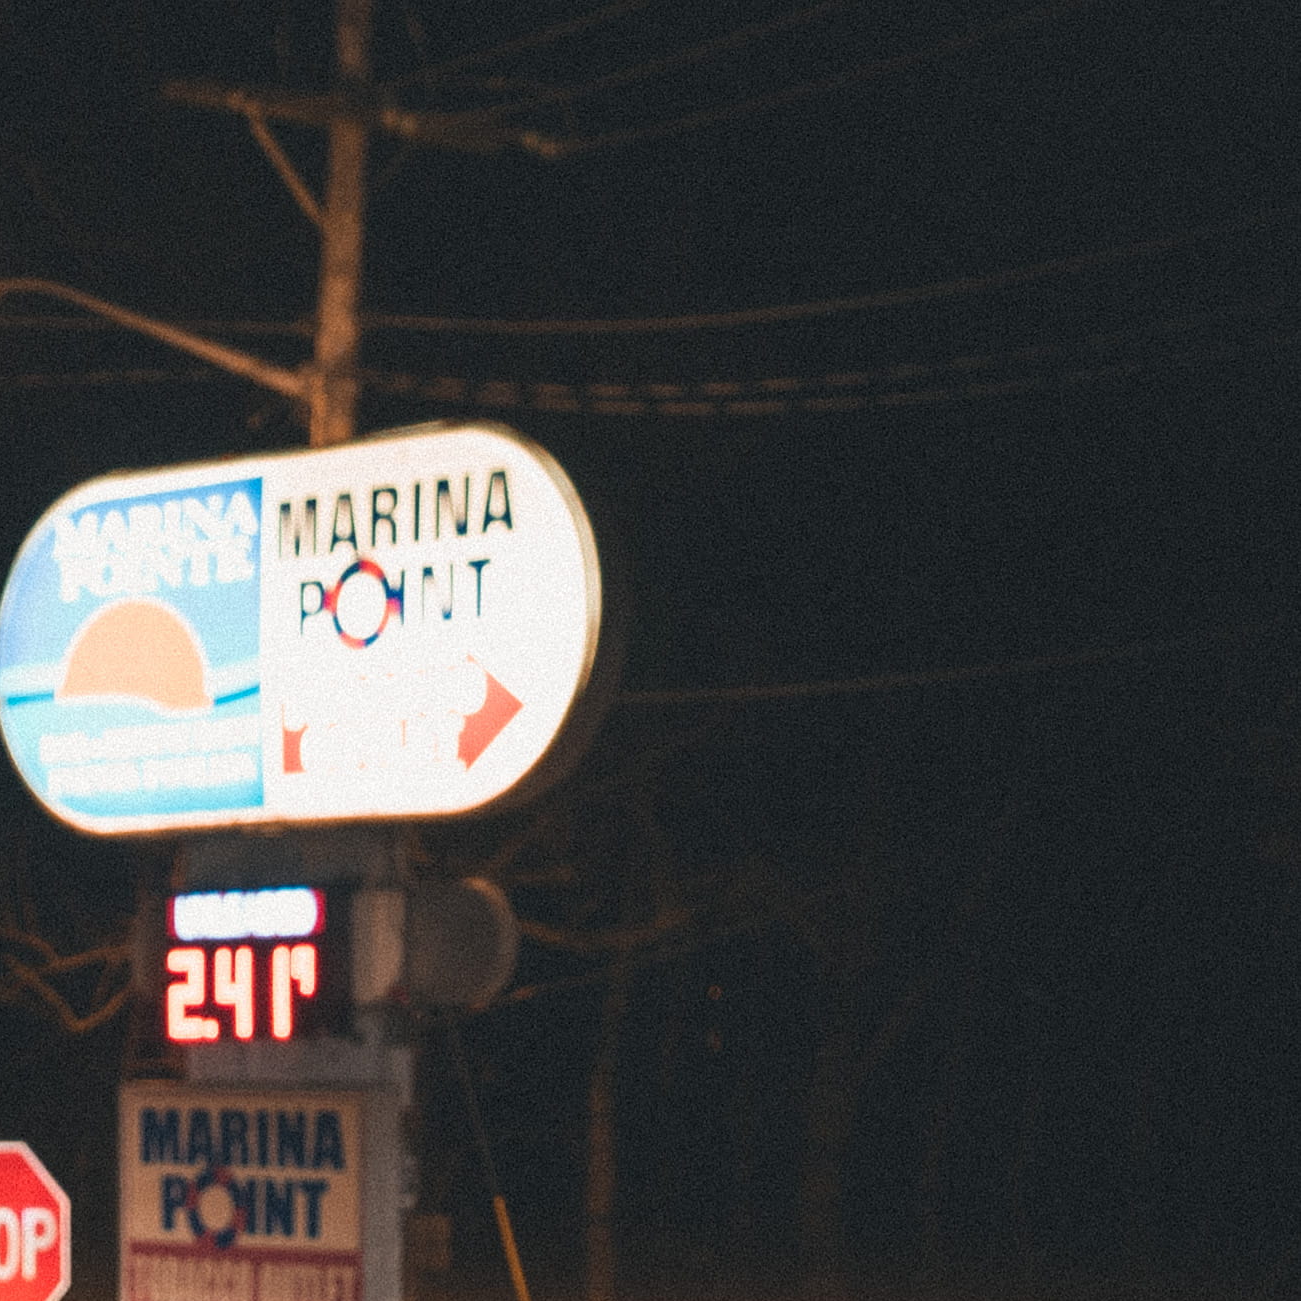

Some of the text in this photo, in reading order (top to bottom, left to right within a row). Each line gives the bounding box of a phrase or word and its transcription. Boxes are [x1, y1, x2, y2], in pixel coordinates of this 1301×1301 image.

[278, 469, 514, 558] MARINA
[299, 558, 491, 650] POINT
[139, 1107, 346, 1171] MARINA
[161, 1166, 331, 1249] POINT
